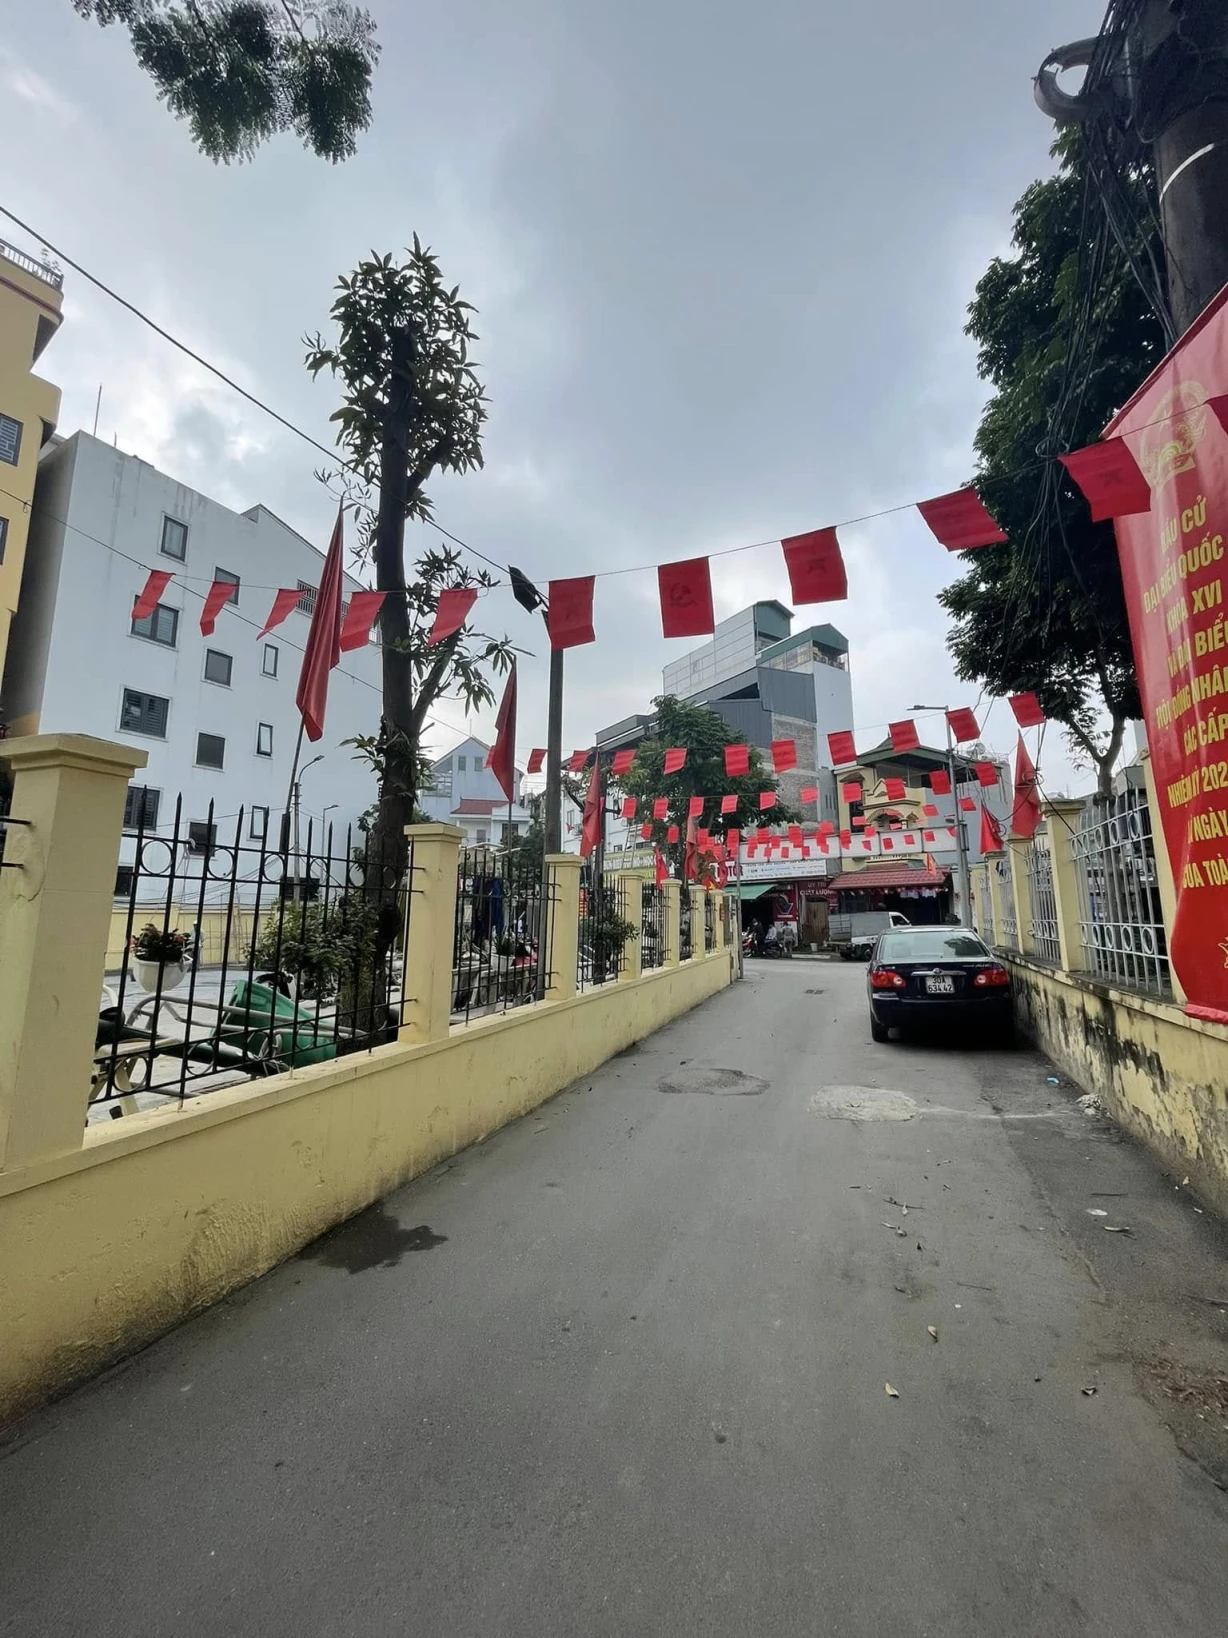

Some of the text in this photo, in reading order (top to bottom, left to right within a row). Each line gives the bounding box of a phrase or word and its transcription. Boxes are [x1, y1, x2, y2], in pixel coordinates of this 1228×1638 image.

[1181, 494, 1206, 533] CỬ
[1143, 583, 1160, 613] ĐẠI
[1178, 531, 1224, 579] QUỐC
[1191, 579, 1222, 614] XVI
[1198, 706, 1228, 746] CẤP
[1202, 853, 1228, 886] TOÀ
[932, 975, 946, 984] 30A
